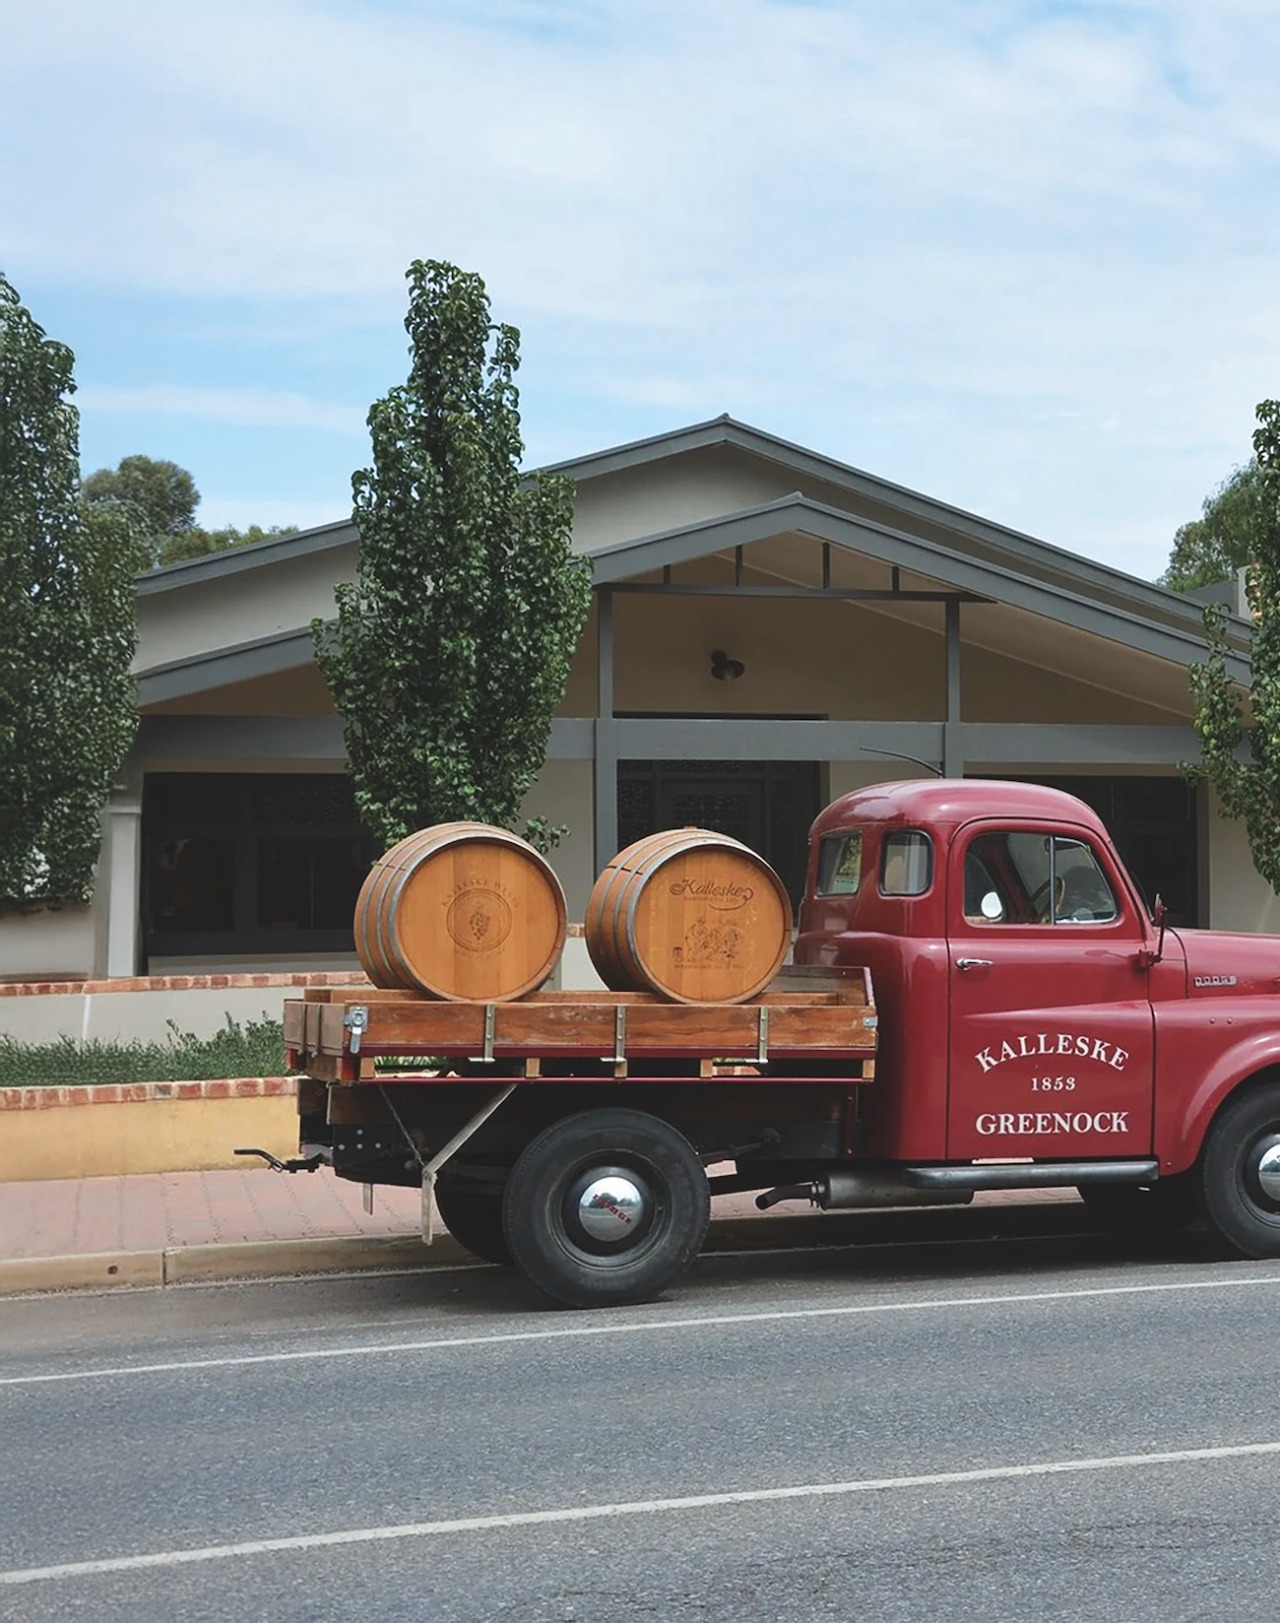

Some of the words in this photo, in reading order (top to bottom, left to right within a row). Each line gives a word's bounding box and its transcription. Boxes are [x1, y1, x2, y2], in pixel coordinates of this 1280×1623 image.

[669, 879, 754, 900] Kalleske
[975, 1033, 1129, 1073] KALLESKE
[1031, 1076, 1076, 1092] 1853
[975, 1111, 1129, 1135] GREENOCK
